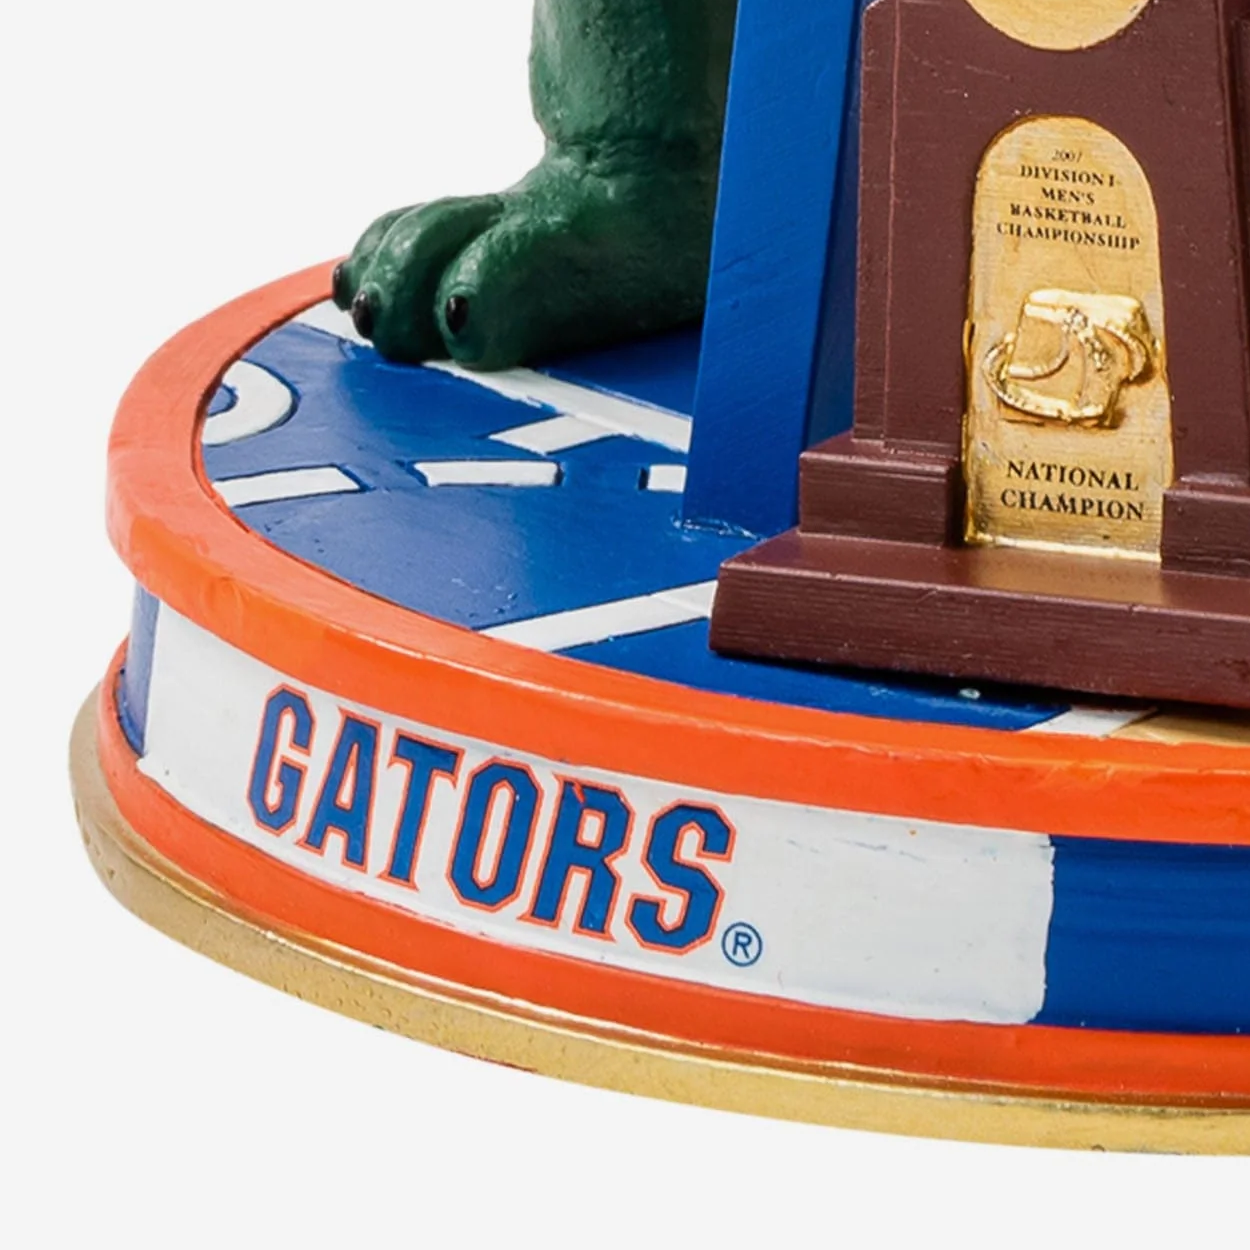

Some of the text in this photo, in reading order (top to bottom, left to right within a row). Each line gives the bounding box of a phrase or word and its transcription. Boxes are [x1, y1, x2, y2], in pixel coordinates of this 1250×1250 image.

[1020, 164, 1104, 187] DIVISION
[1040, 186, 1095, 206] MEN'S
[1009, 203, 1127, 229] BASKETBALL
[996, 222, 1141, 250] CHAMPIONSHIP
[1006, 460, 1139, 491] NATIONAL
[1000, 488, 1145, 520] CHAMPION
[246, 682, 737, 957] GATORS
